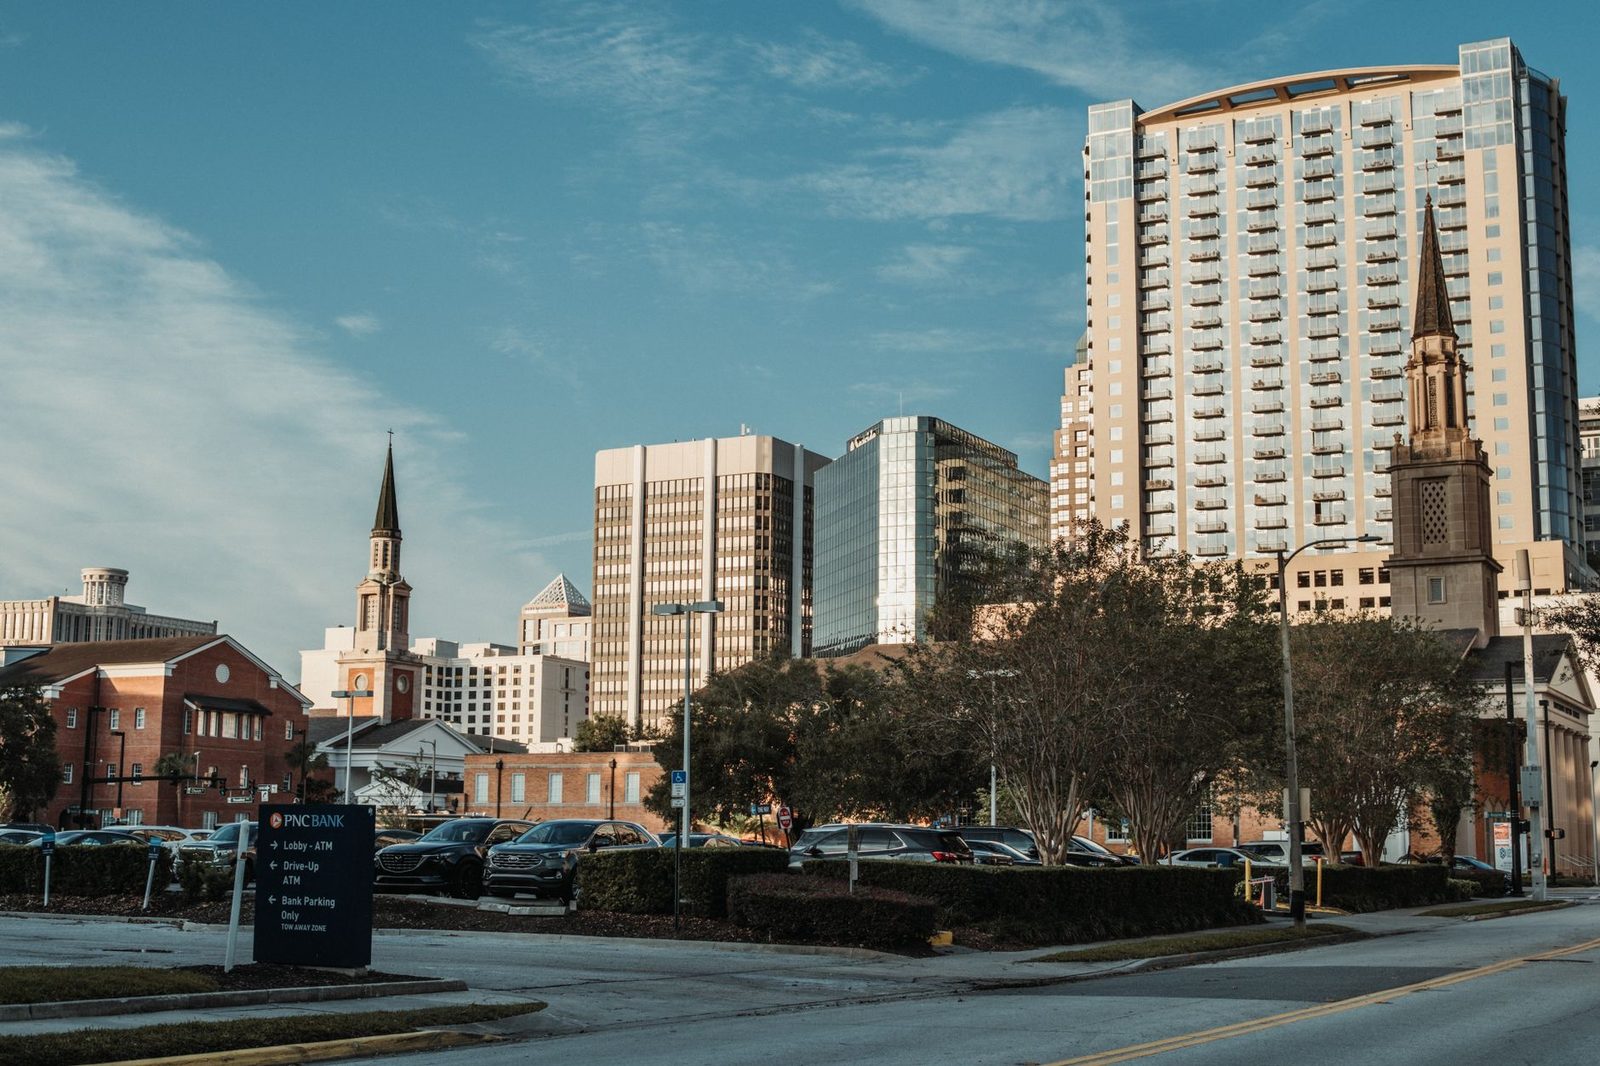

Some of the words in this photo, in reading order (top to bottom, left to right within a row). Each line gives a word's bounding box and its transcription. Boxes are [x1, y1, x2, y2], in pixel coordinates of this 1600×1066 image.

[283, 841, 308, 852] Lobby
[315, 841, 333, 850] ATM
[283, 861, 319, 873] Drive-Up
[283, 876, 301, 885] ATM
[282, 895, 302, 906] Bank
[304, 896, 335, 909] Parking
[281, 911, 299, 922] Only
[311, 924, 327, 932] ZONE
